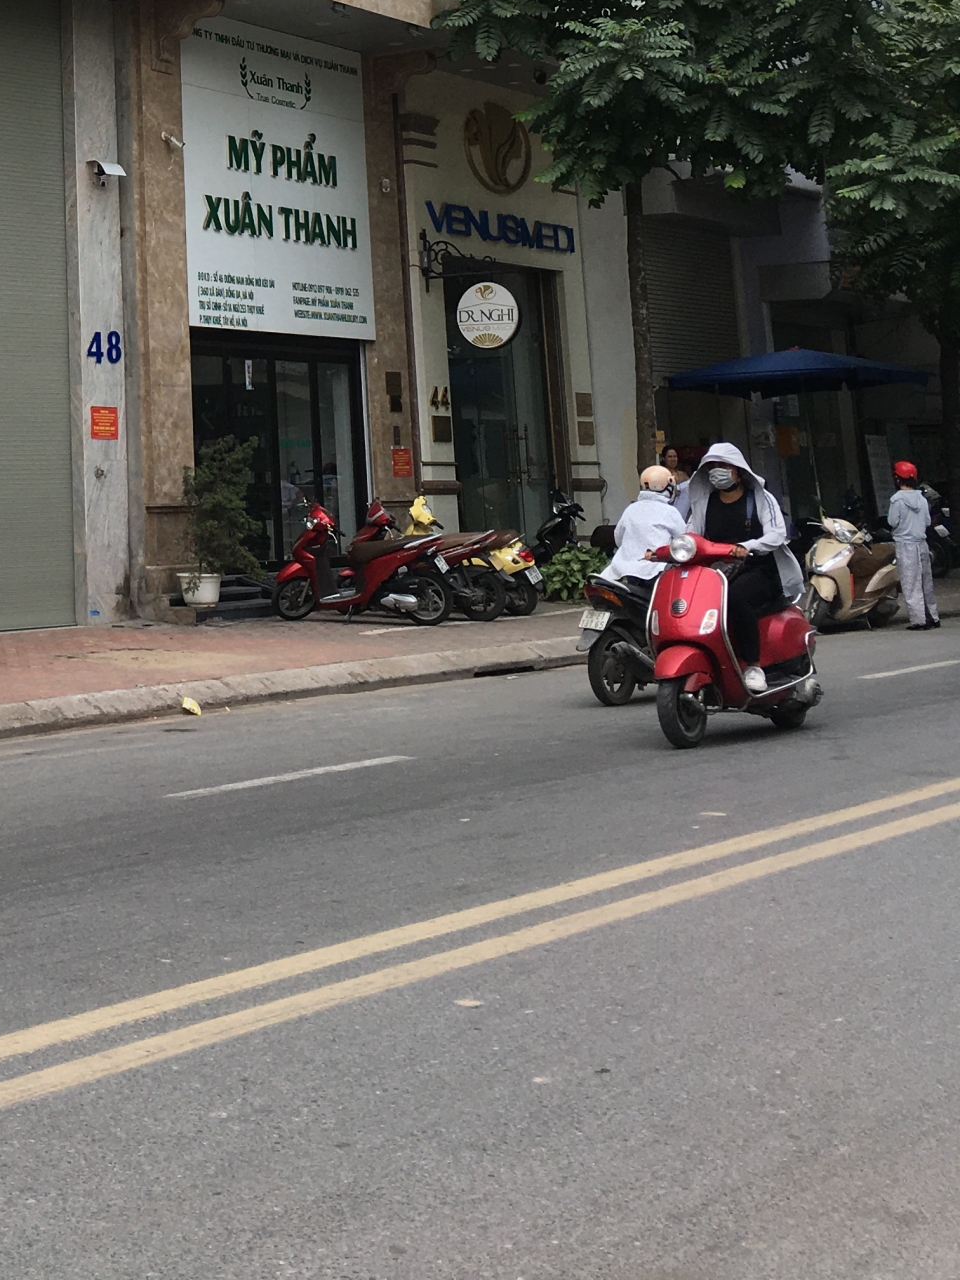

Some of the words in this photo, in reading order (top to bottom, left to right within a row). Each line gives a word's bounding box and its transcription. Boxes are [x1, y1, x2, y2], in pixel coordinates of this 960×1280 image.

[203, 29, 213, 41] TY
[214, 32, 231, 45] TNHH
[231, 34, 245, 49] ĐẦU
[280, 48, 292, 62] MẠI
[292, 50, 301, 63] VÀ
[301, 54, 314, 66] DỊCH
[314, 57, 323, 69] VỤ
[323, 58, 339, 72] XUÂN
[339, 63, 358, 76] THANH
[249, 70, 273, 88] Xuân
[276, 76, 303, 95] Thanh
[256, 92, 270, 104] True
[271, 96, 296, 109] Cosmetic
[227, 130, 265, 174] MỸ
[270, 133, 337, 188] PHẨM
[203, 191, 274, 238] XUÂN
[278, 206, 358, 249] THANH
[87, 331, 122, 364] 48
[429, 385, 450, 411] 44
